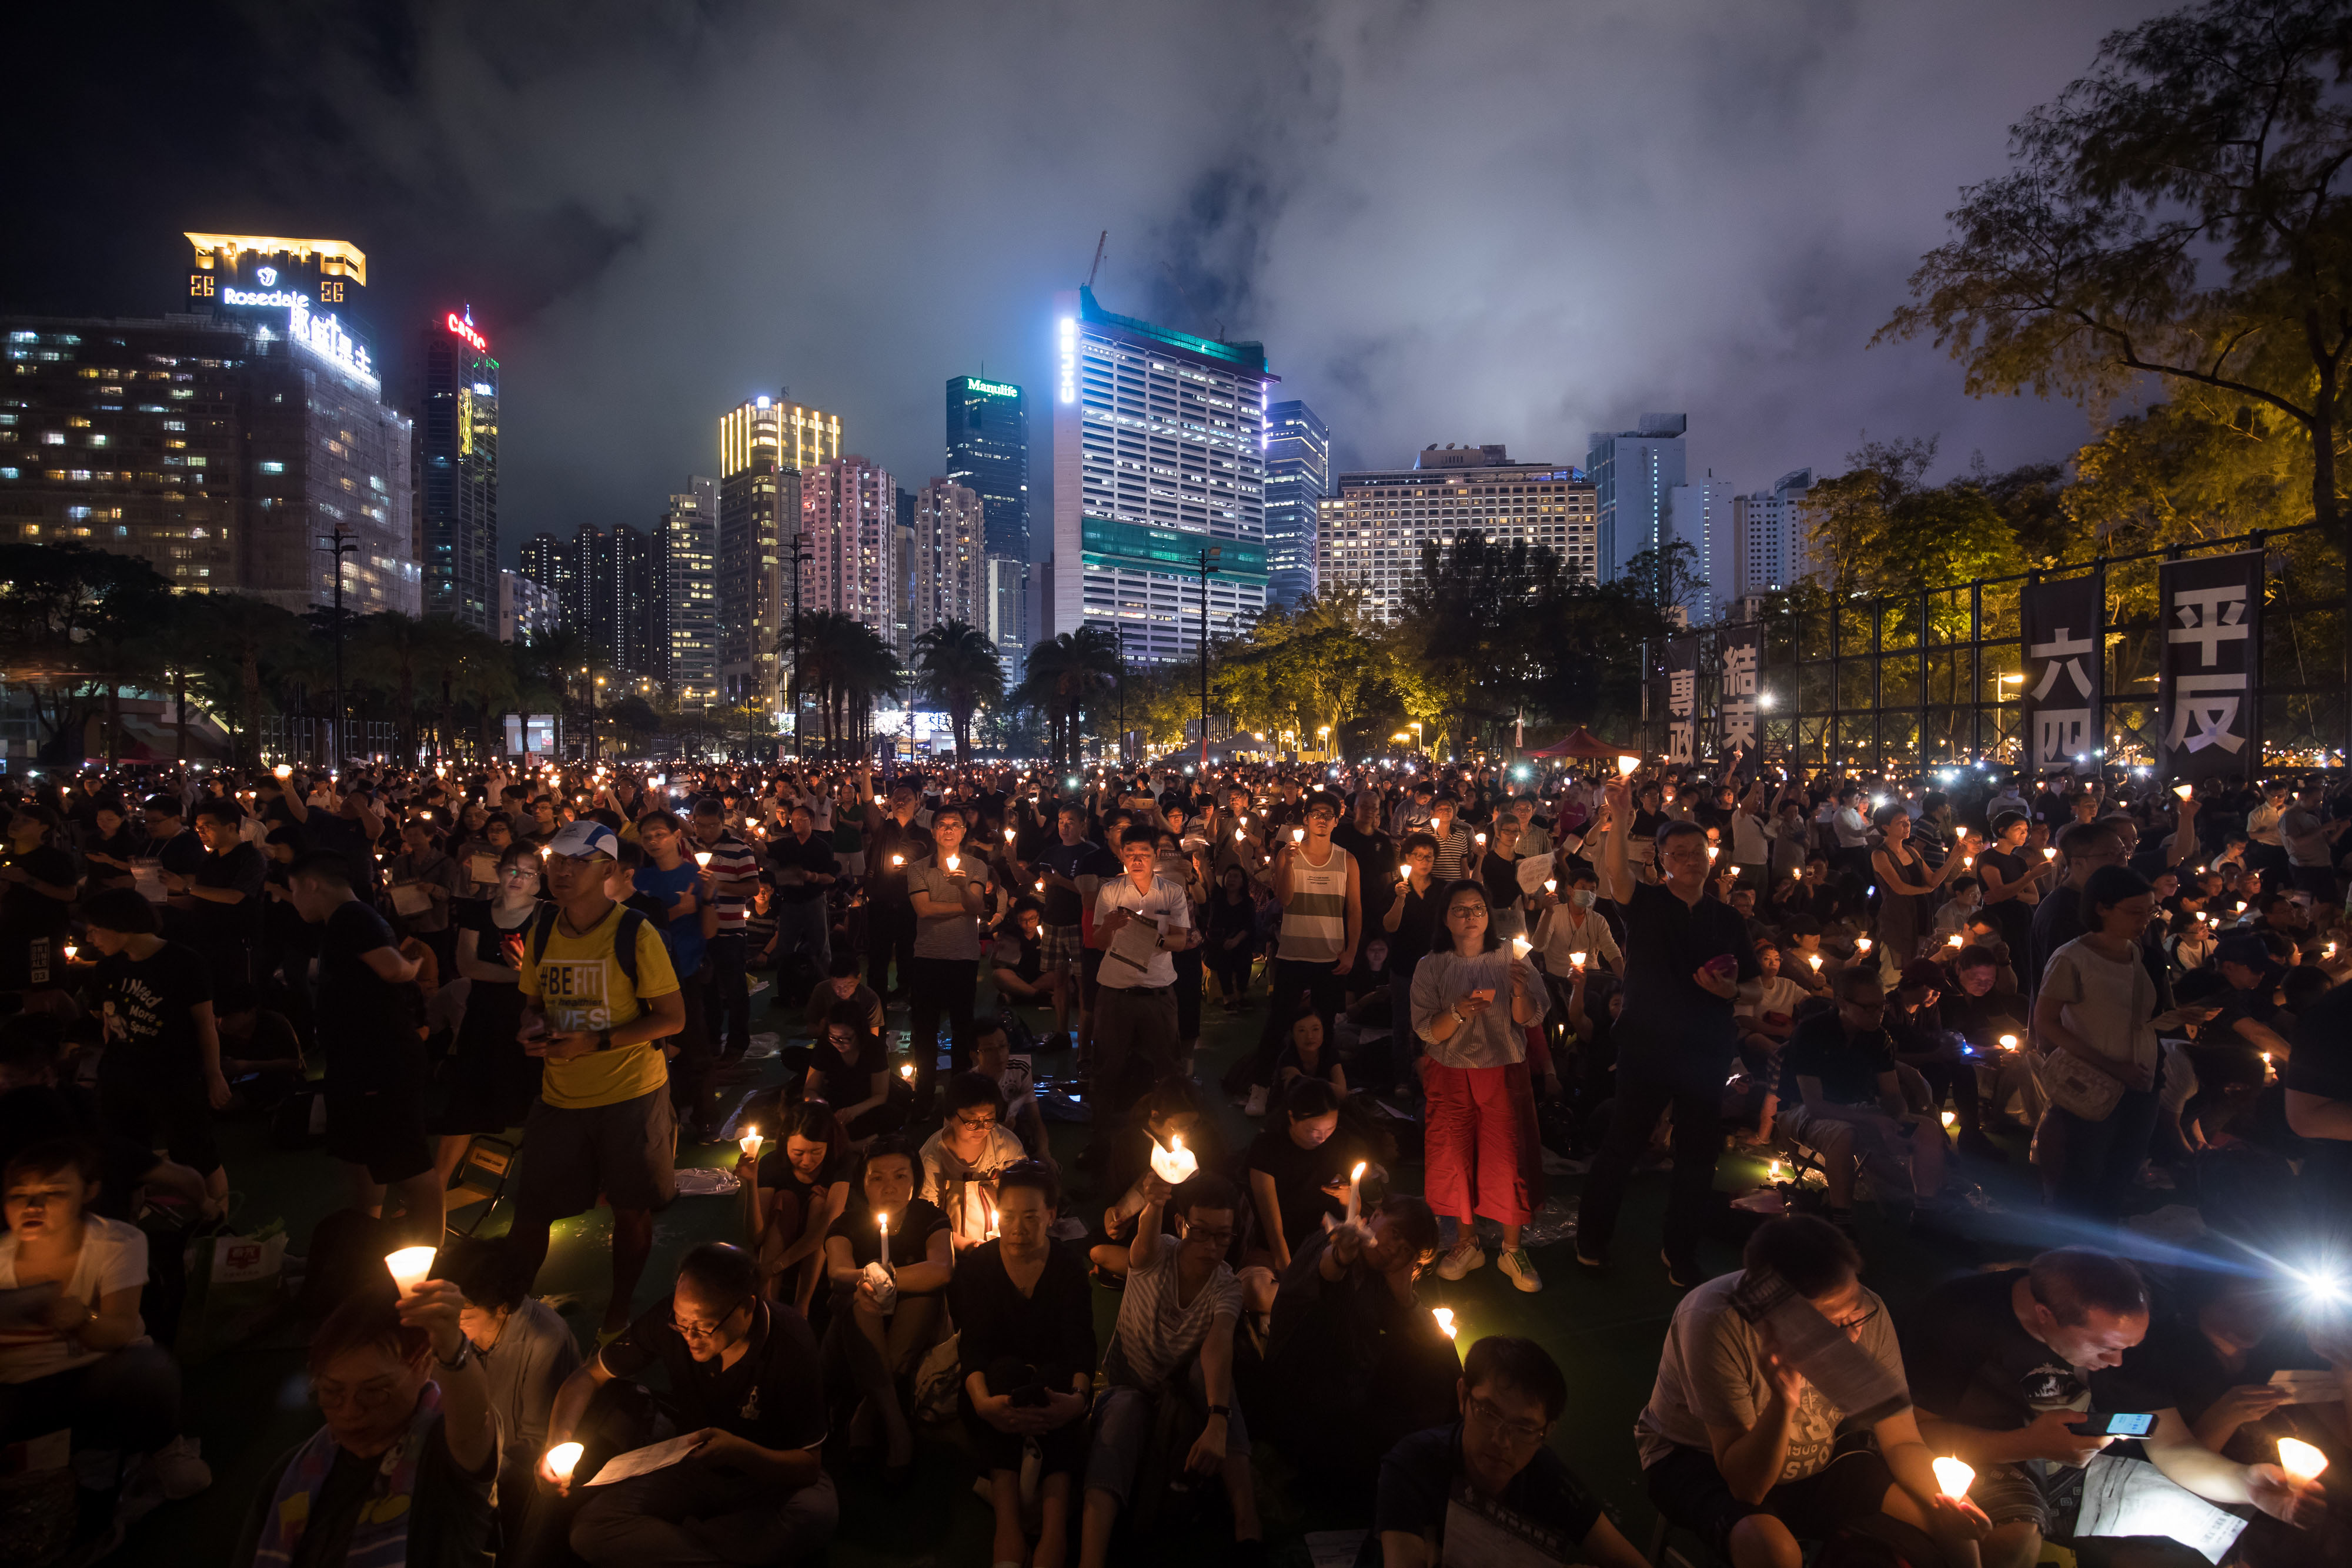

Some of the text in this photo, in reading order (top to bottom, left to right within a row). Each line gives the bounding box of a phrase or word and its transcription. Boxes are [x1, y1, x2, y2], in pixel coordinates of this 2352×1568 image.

[223, 287, 309, 307] Rosedale
[449, 313, 485, 353] CATIC
[967, 378, 1018, 397] Manulife
[2165, 584, 2249, 755] 平反
[1722, 644, 1756, 750] 結束
[2030, 627, 2093, 775] 六四
[1669, 669, 1695, 766] 專政
[120, 978, 163, 1009] I Need
[540, 966, 600, 995] #BEFIT
[129, 1004, 156, 1022] More
[559, 998, 603, 1007] healthier
[131, 1020, 159, 1036] Space
[553, 1008, 607, 1031] VES
